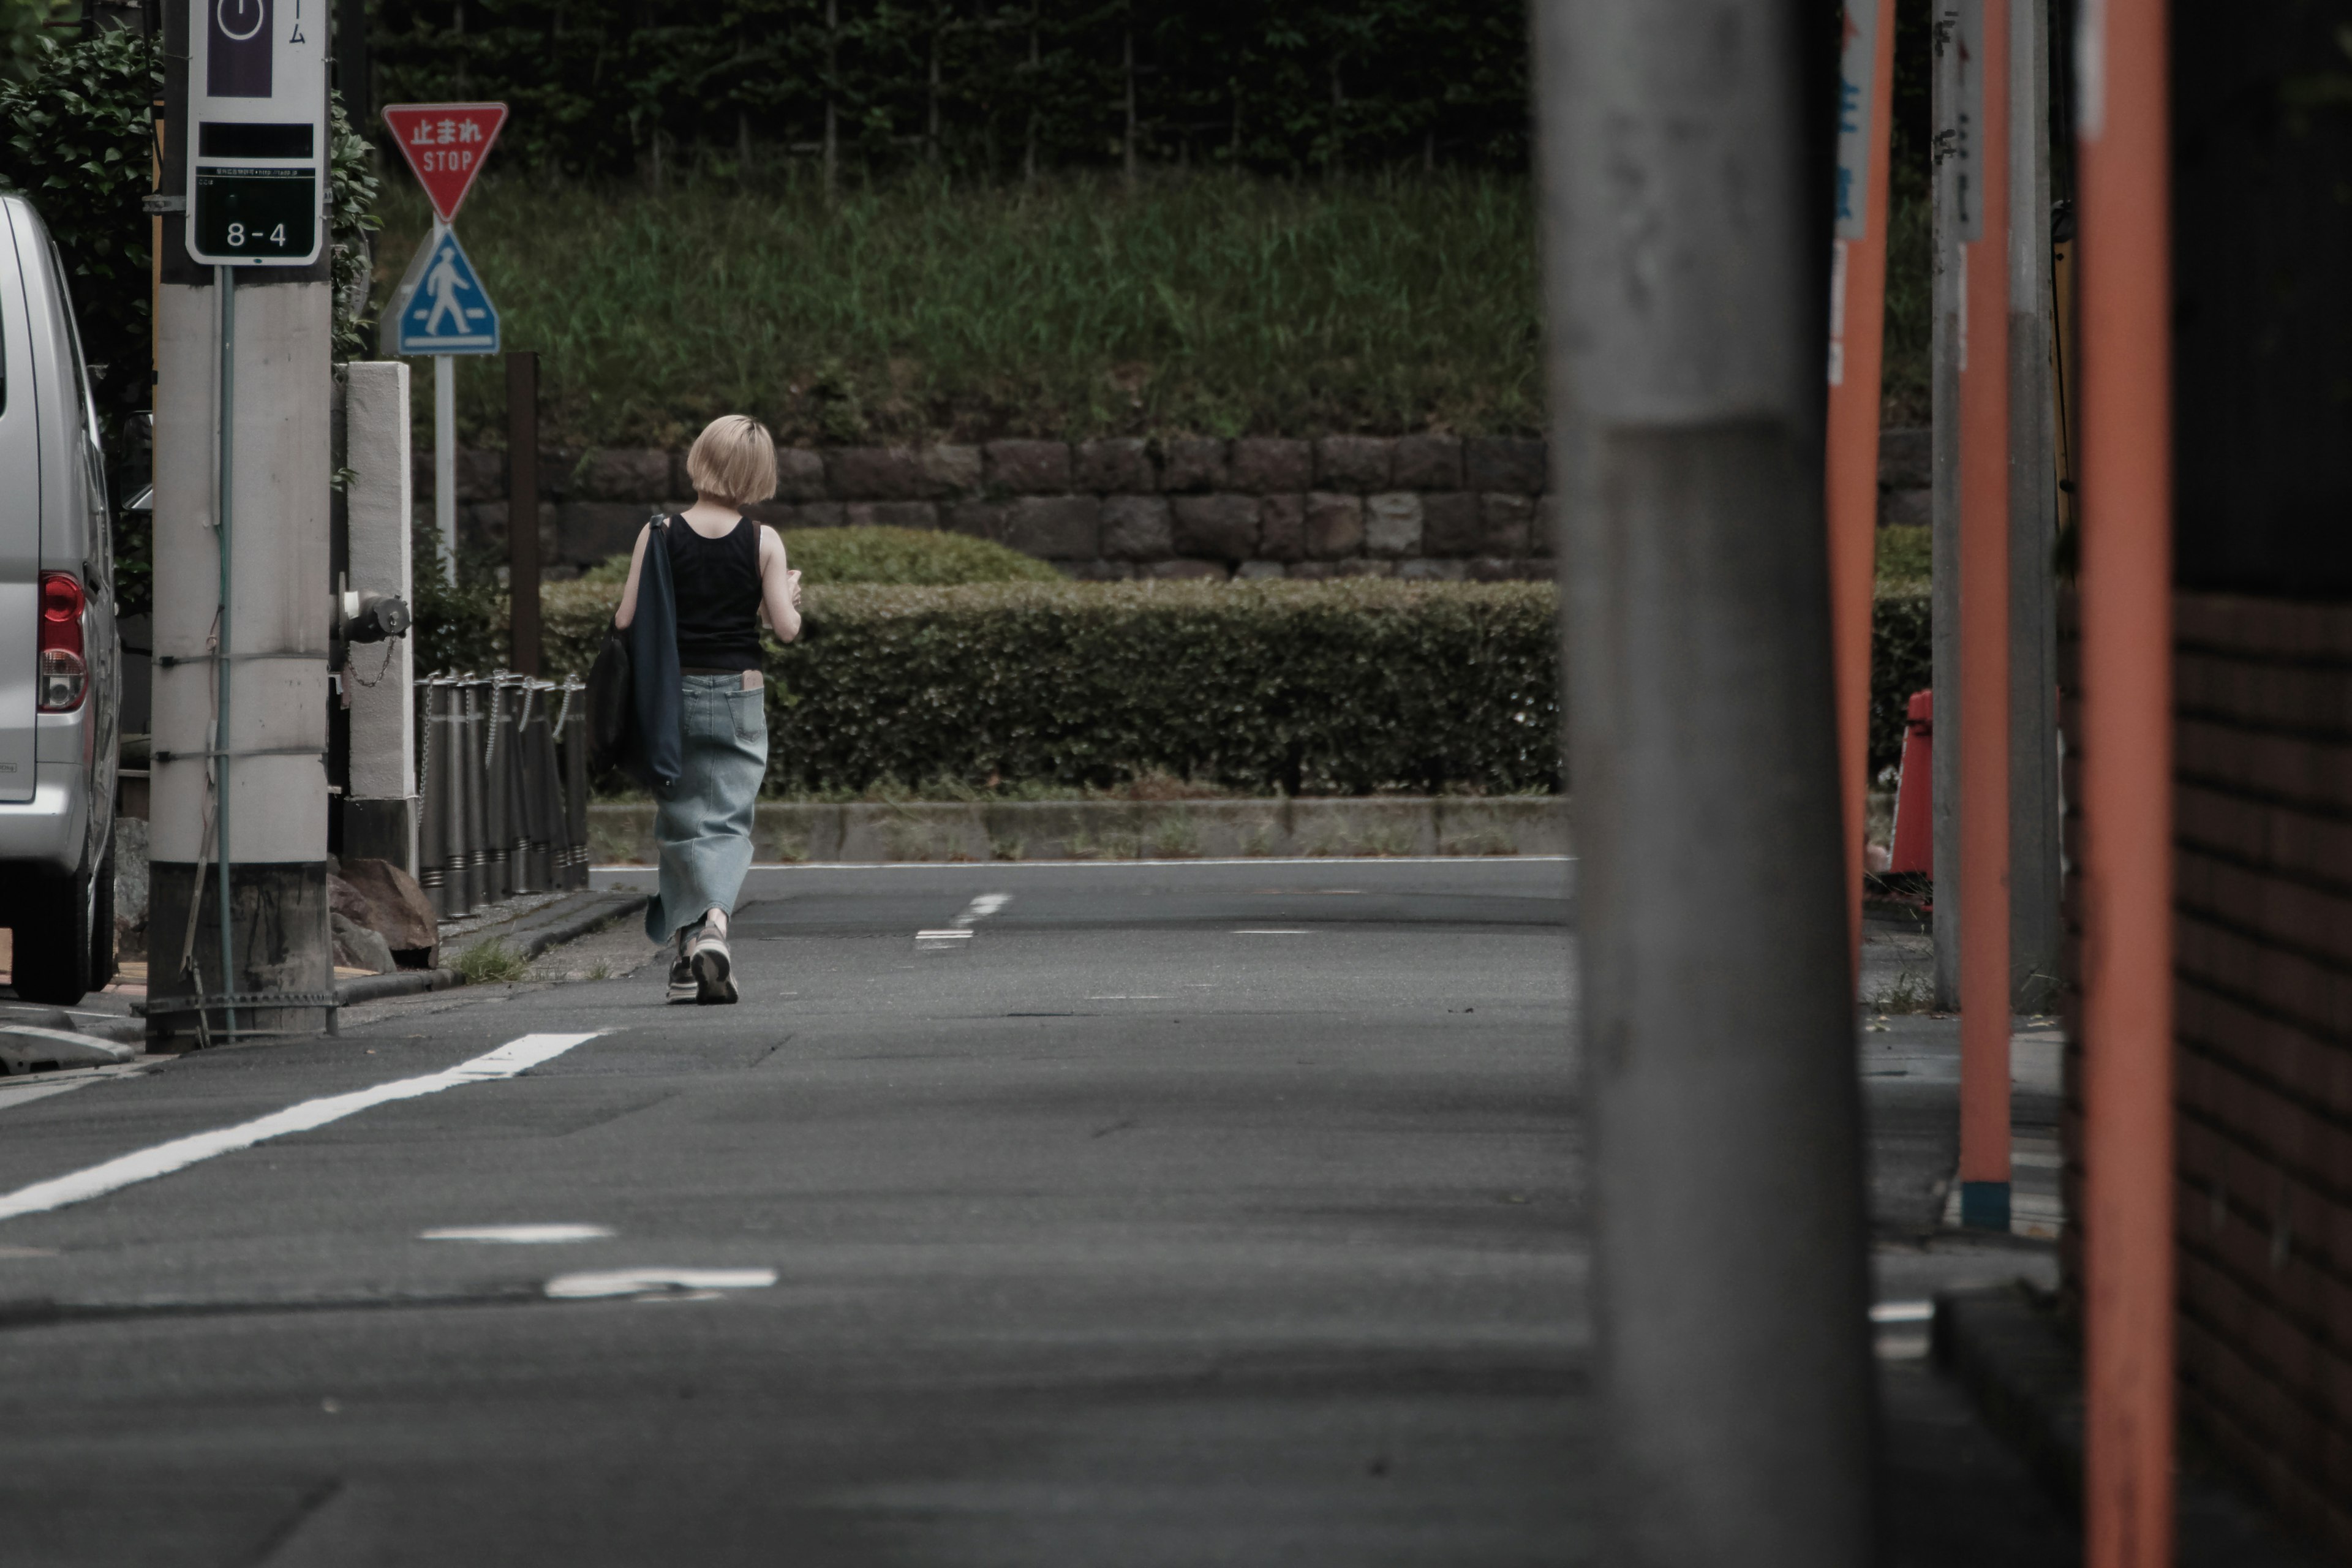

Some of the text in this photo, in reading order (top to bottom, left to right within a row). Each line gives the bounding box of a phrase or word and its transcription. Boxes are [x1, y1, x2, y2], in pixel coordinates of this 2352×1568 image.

[410, 118, 481, 145] 止まれ
[424, 151, 472, 172] STOP
[227, 223, 286, 247] 8-4
